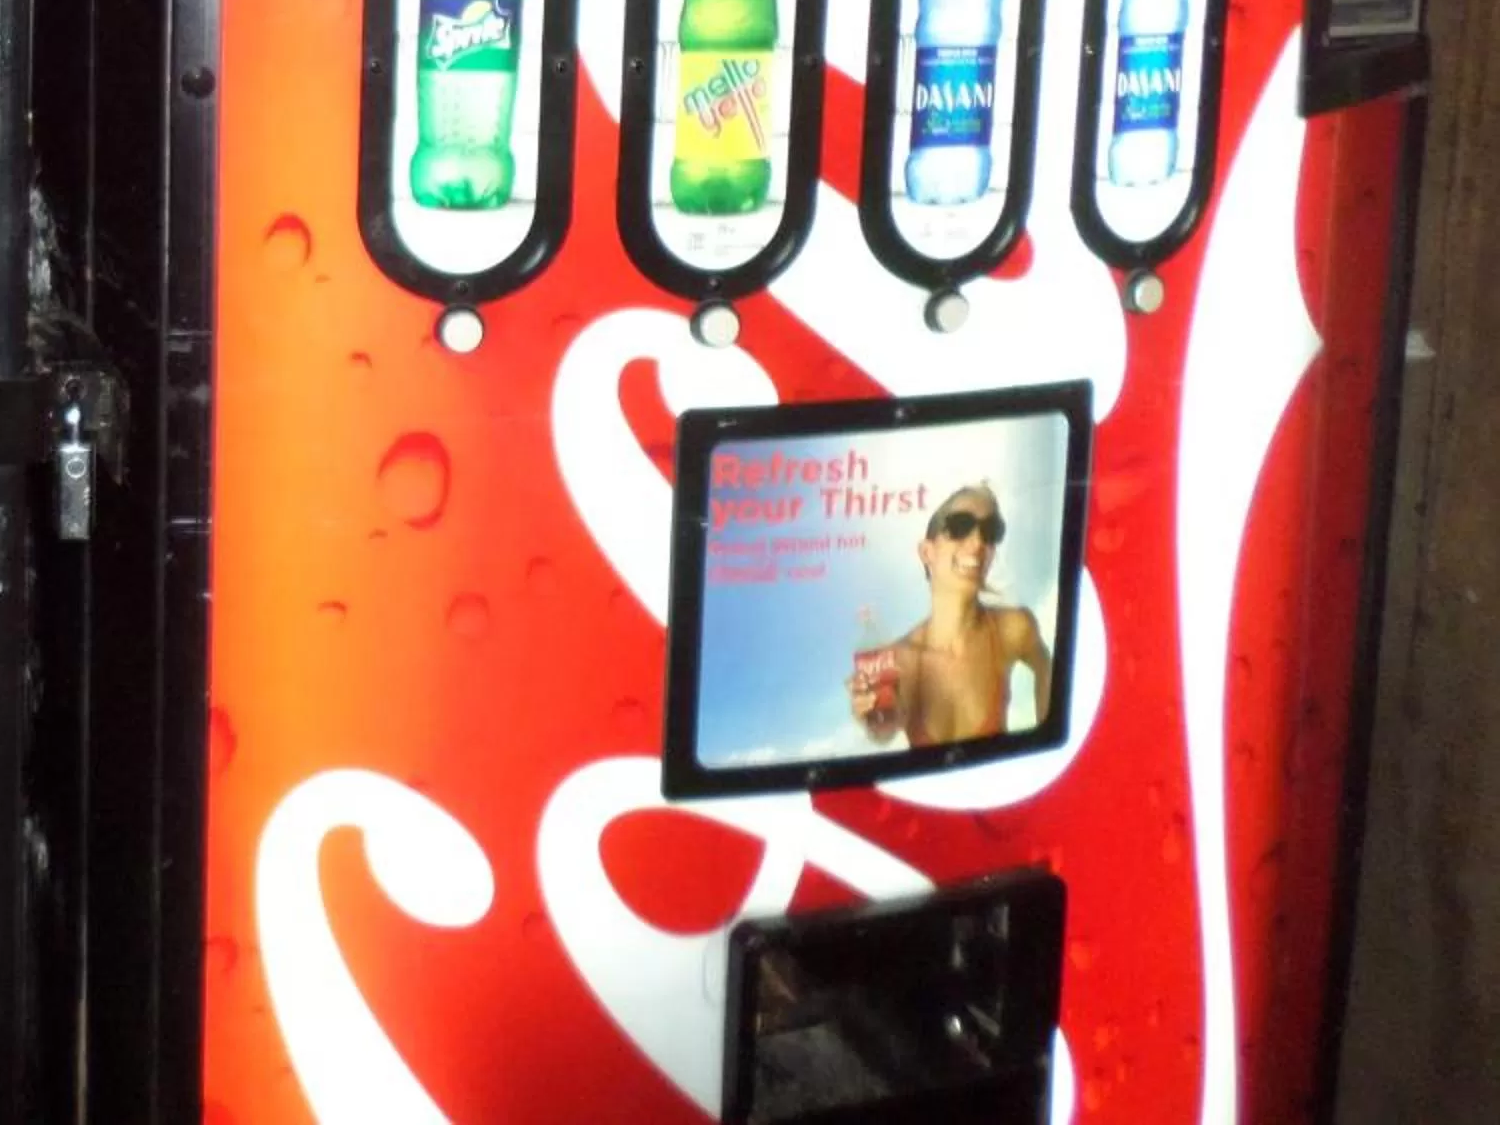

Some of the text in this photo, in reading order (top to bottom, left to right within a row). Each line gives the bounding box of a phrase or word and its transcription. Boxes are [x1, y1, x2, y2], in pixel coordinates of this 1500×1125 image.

[684, 58, 760, 116] mello
[916, 81, 994, 111] DASANI
[1117, 68, 1182, 96] DASANI
[699, 77, 768, 158] yello
[711, 448, 869, 489] Refresh
[710, 482, 929, 532] your Thirst
